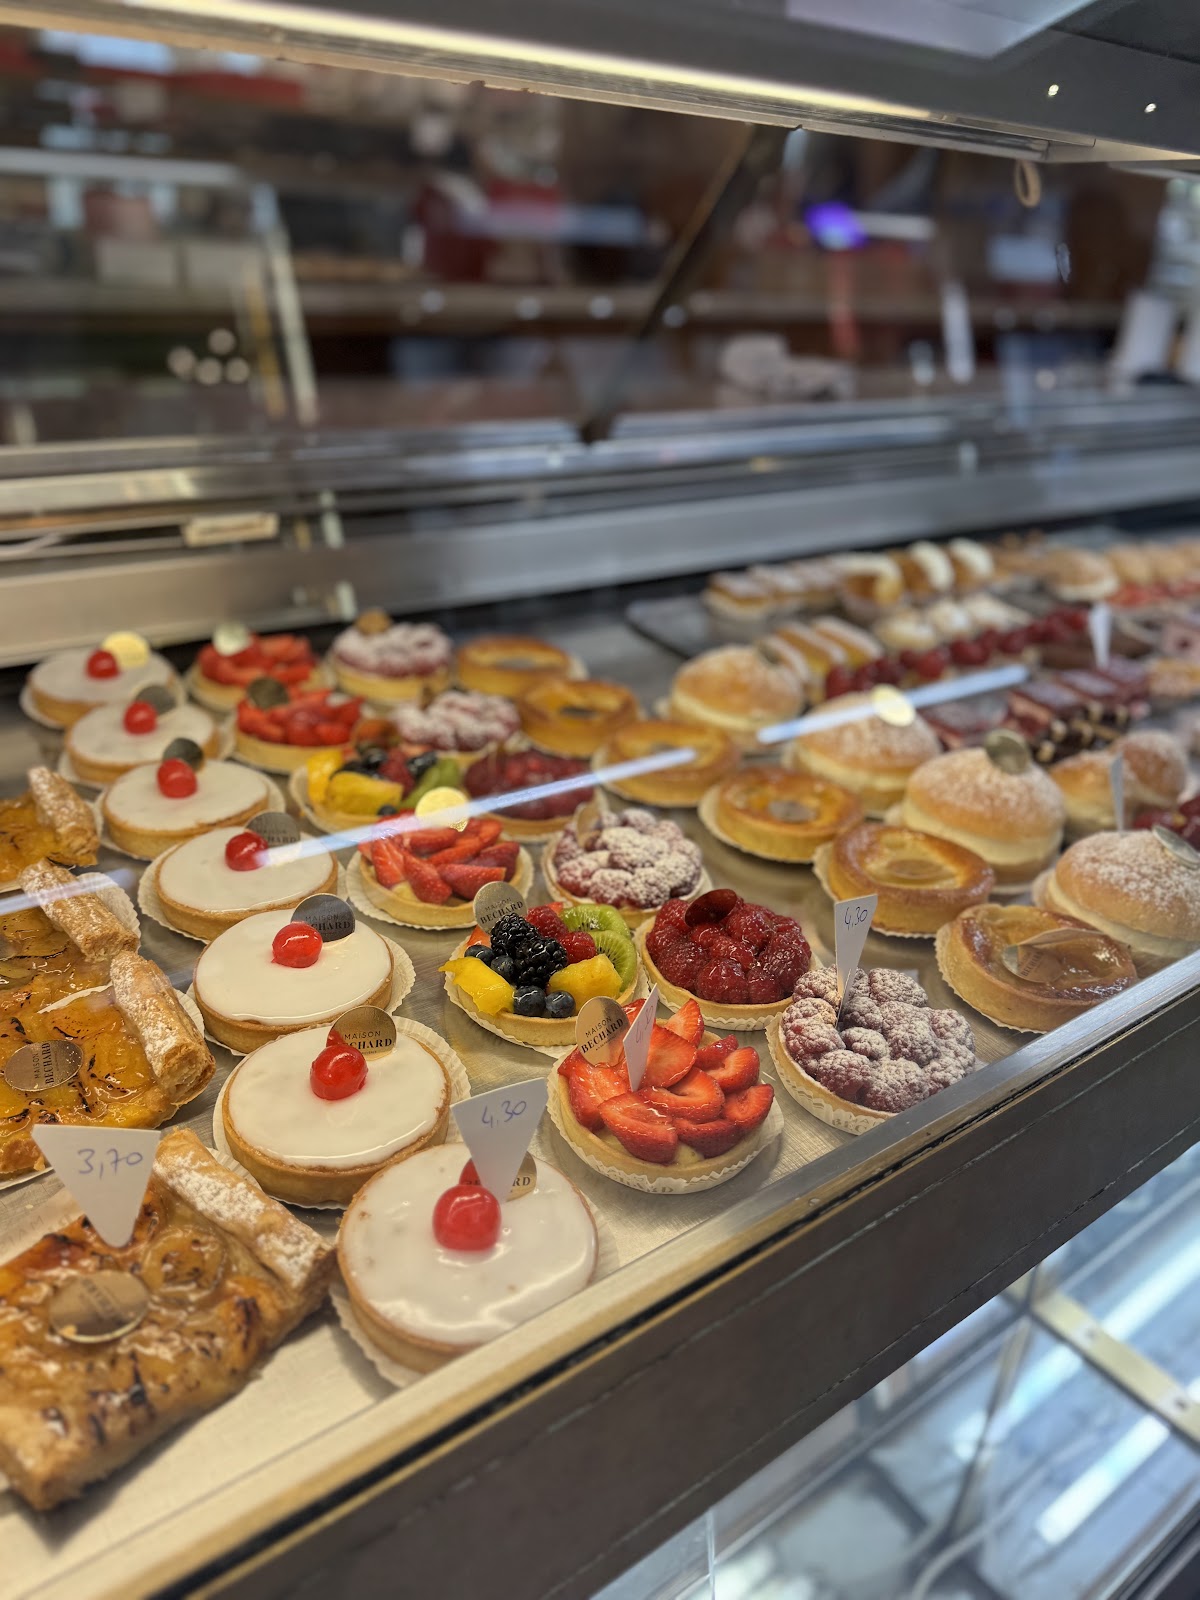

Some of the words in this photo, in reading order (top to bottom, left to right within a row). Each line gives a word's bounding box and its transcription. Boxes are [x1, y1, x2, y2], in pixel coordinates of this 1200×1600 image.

[480, 901, 524, 924] BECHARD
[311, 921, 351, 931] CHARD
[344, 1030, 381, 1040] MAISON
[581, 1018, 624, 1054] BECHARD
[585, 1016, 612, 1038] MAISON
[346, 1038, 393, 1050] CHARD
[32, 1052, 41, 1079] MAISON
[41, 1042, 55, 1085] BECHARD
[77, 1147, 144, 1179] 3,70
